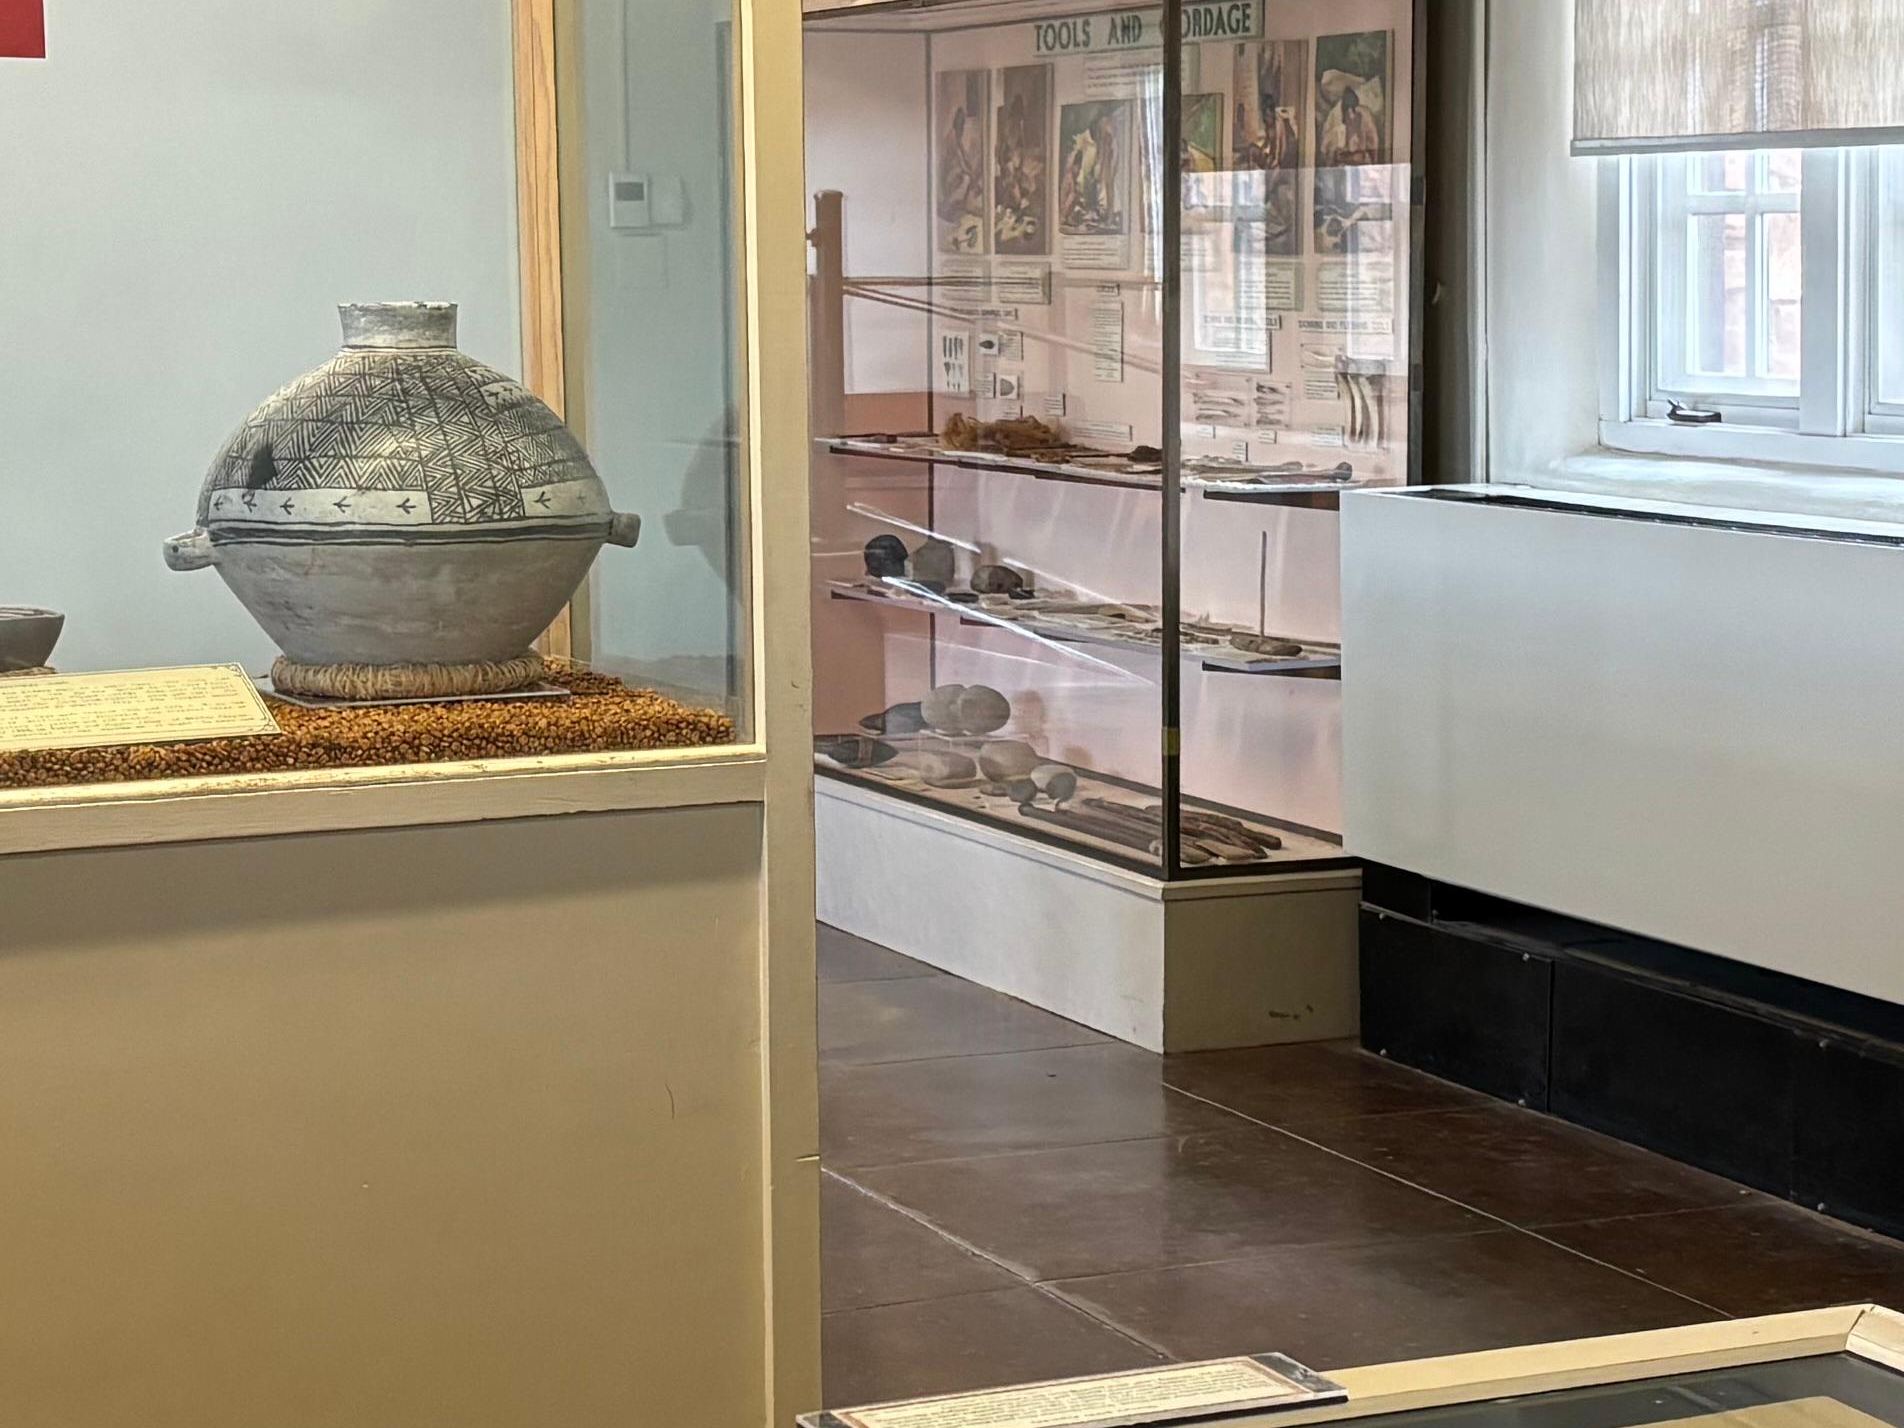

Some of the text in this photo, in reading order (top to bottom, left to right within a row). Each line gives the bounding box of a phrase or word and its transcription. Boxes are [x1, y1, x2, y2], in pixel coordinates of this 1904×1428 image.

[1035, 3, 1251, 52] TOOLS AND ORDAGE
